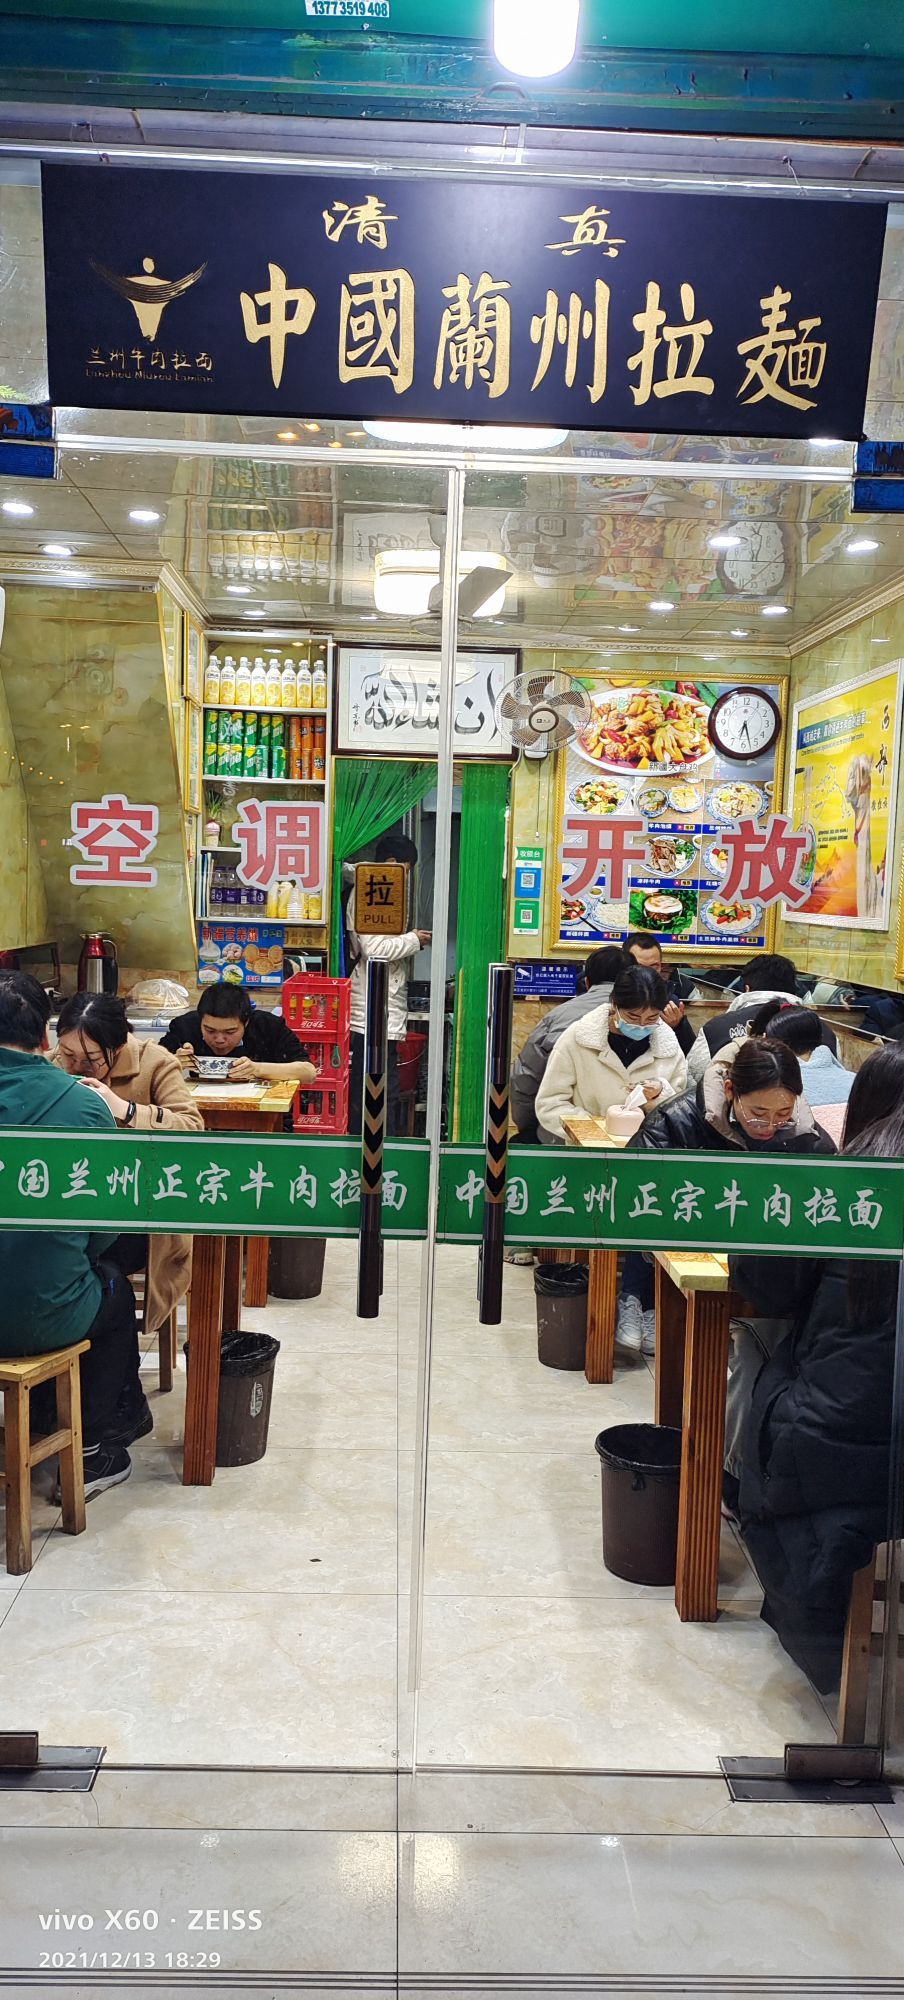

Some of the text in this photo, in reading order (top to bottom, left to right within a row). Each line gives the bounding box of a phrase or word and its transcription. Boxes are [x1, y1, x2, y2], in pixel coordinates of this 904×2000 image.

[365, 874, 394, 906] 拉
[364, 914, 394, 924] PULL
[0, 1157, 408, 1211] 国兰州正宗牛肉拉面
[455, 1169, 883, 1229] 中国兰州正宗牛肉拉面
